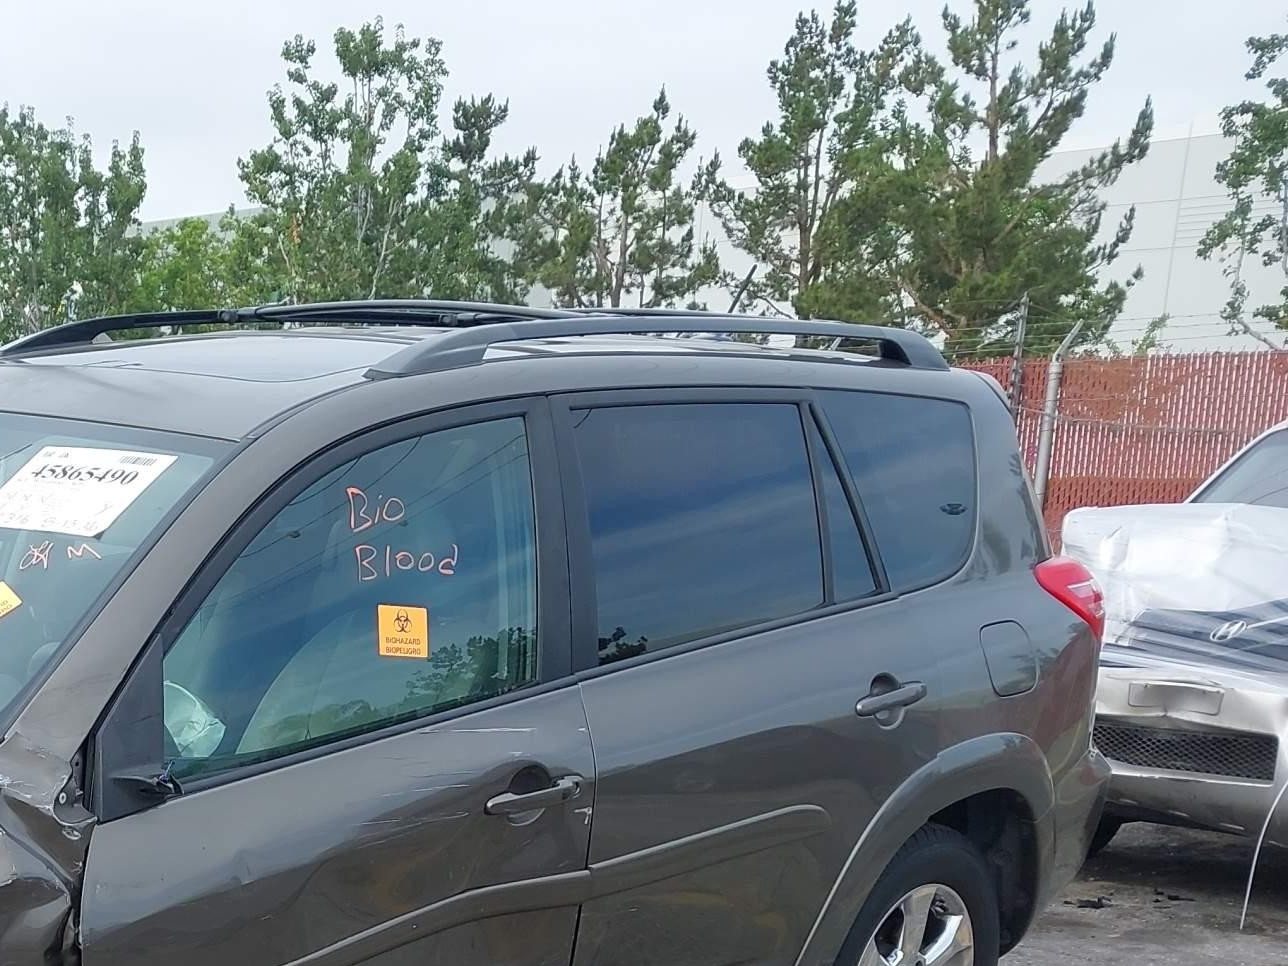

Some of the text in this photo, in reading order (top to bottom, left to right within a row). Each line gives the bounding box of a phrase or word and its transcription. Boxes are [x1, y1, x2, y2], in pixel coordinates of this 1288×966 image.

[31, 463, 140, 486] 45865490
[345, 486, 406, 533] Bio
[355, 543, 459, 583] Blood
[385, 636, 421, 646] BIOHAZARD
[385, 646, 421, 656] BIOPELIGRO
